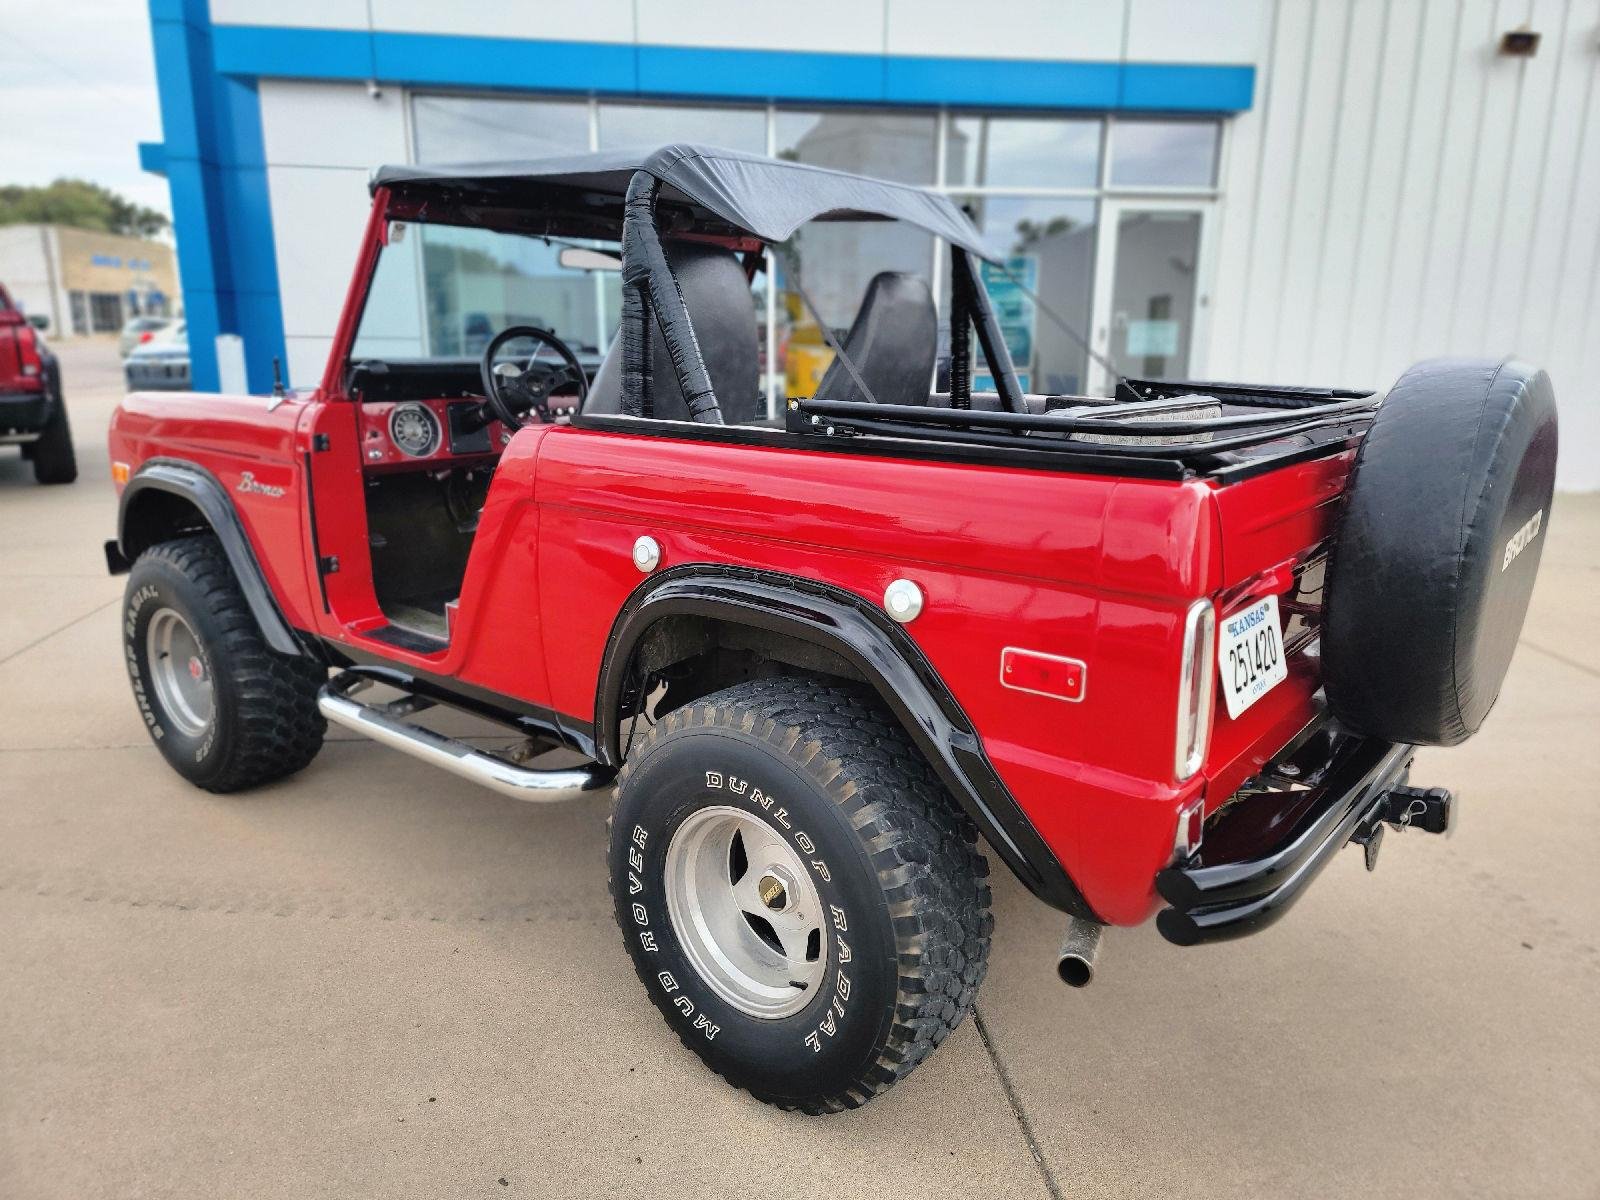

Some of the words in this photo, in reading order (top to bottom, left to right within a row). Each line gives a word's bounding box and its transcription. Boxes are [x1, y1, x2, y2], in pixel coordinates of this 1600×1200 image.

[1231, 605, 1267, 638] KANSAS
[1229, 625, 1277, 694] 251420
[628, 825, 660, 953] ROVER
[705, 771, 832, 883] DUNLOP
[804, 904, 852, 1053] RADIAL
[658, 970, 721, 1041] MUD
